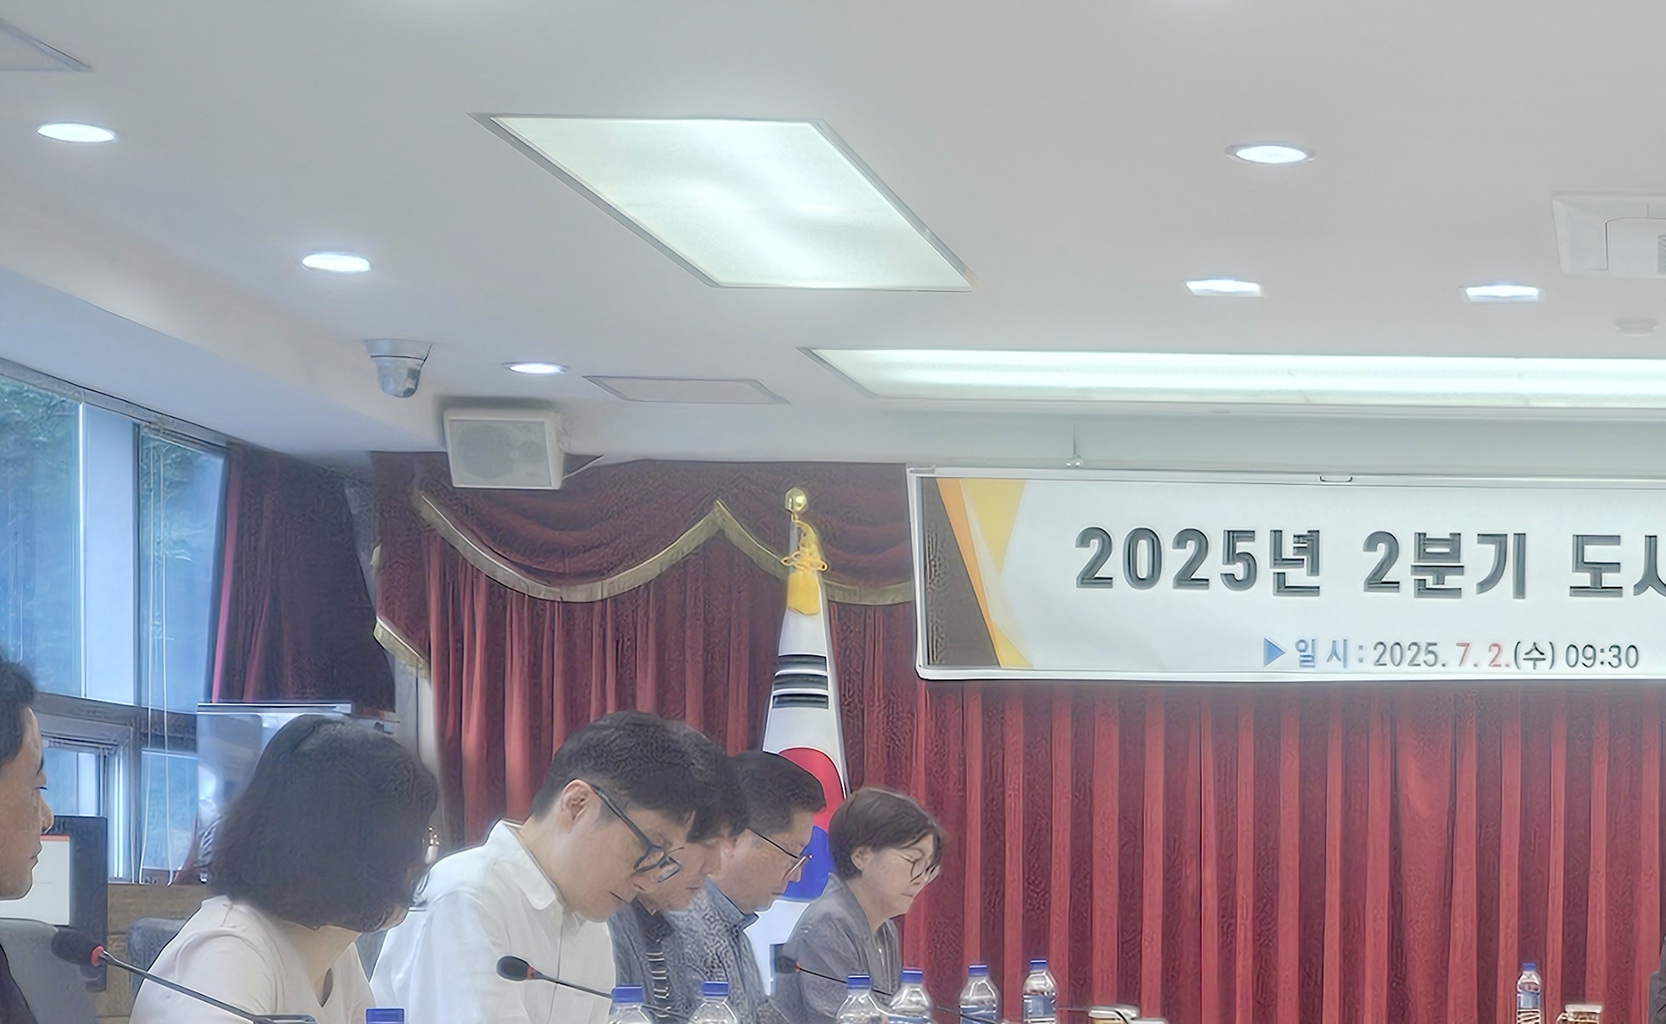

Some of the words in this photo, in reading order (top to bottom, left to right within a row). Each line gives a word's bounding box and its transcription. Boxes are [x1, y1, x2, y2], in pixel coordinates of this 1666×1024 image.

[1075, 526, 1320, 597] 2025년
[1363, 530, 1527, 600] 2분기
[1373, 640, 1446, 667] 2025.
[1565, 643, 1640, 669] 09:30
